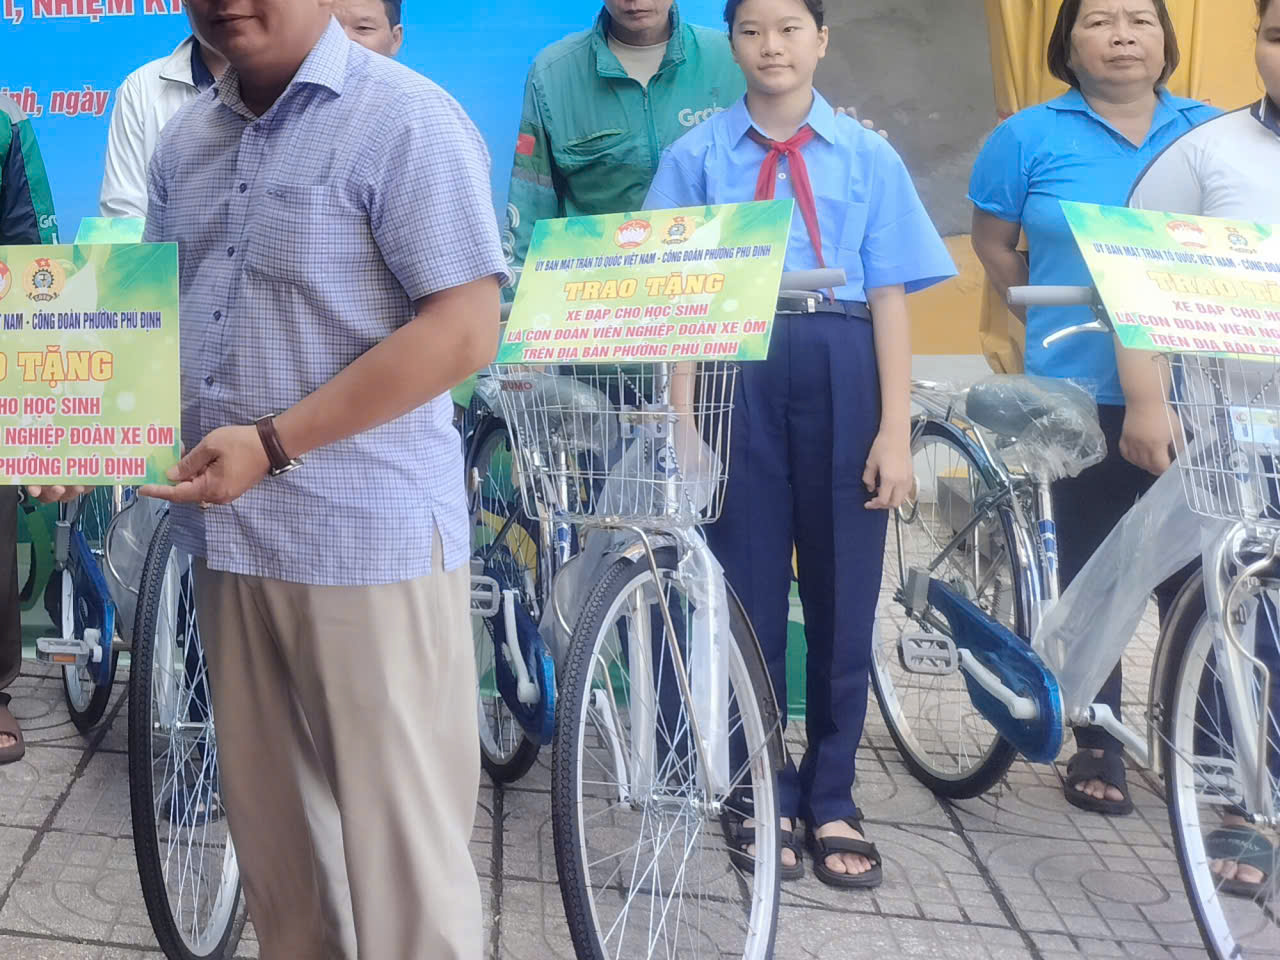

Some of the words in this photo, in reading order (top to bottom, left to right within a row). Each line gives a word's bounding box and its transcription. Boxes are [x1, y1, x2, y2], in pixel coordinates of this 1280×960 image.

[49, 85, 110, 117] ngày
[565, 278, 637, 301] TRAO
[645, 272, 725, 304] TẶNG
[4, 313, 23, 330] NAM
[32, 309, 55, 330] CÔNG
[58, 309, 80, 329] ĐOÀN
[83, 308, 118, 329] PHƯỜNG
[121, 308, 137, 328] PHÚ
[141, 312, 161, 332] ĐỊNH
[566, 311, 582, 321] XE
[585, 309, 611, 322] ĐẠP
[614, 307, 640, 319] CHO
[644, 305, 671, 320] HỌC
[675, 304, 709, 316] SINH
[17, 345, 114, 388] TẶNG
[23, 397, 56, 418] HỌC
[61, 397, 101, 415] SINH
[5, 424, 65, 448] NGHIỆP
[70, 425, 115, 444] ĐOÀN
[121, 427, 142, 444] XE
[147, 424, 174, 445] ÔM
[66, 454, 99, 475] PHÚ
[104, 457, 145, 480] ĐỊNH
